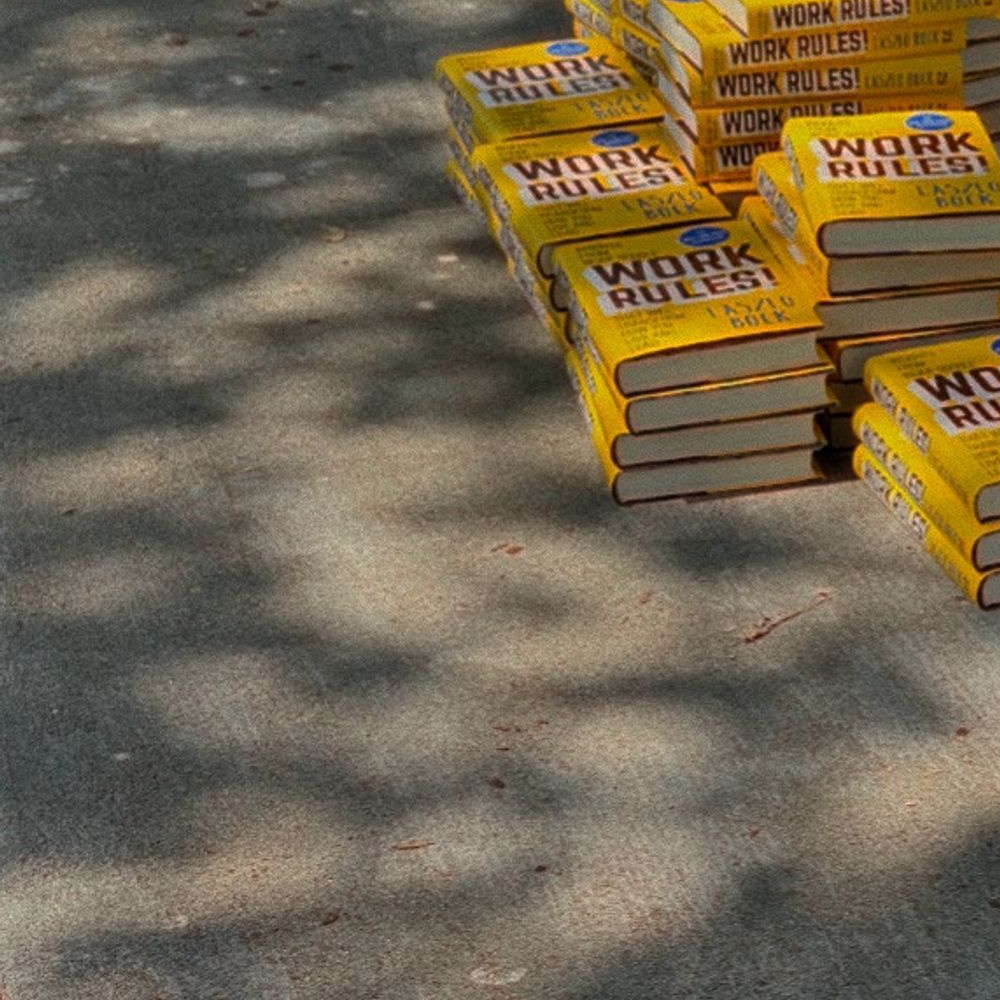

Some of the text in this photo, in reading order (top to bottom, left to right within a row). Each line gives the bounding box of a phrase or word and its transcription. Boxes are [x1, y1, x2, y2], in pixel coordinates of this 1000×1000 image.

[772, 1, 835, 29] WORK
[729, 37, 792, 65] WORK
[797, 30, 868, 58] RULES!
[476, 54, 619, 87] WORK
[717, 72, 780, 98] WORK
[787, 67, 860, 92] RULES!
[487, 72, 632, 104] RULES!
[722, 108, 784, 134] WORK
[819, 132, 981, 158] WORK
[513, 144, 671, 180] WORK
[827, 155, 988, 179] RULES!
[528, 166, 684, 201] RULES!
[593, 243, 763, 286] WORK
[607, 267, 777, 309] RULES!
